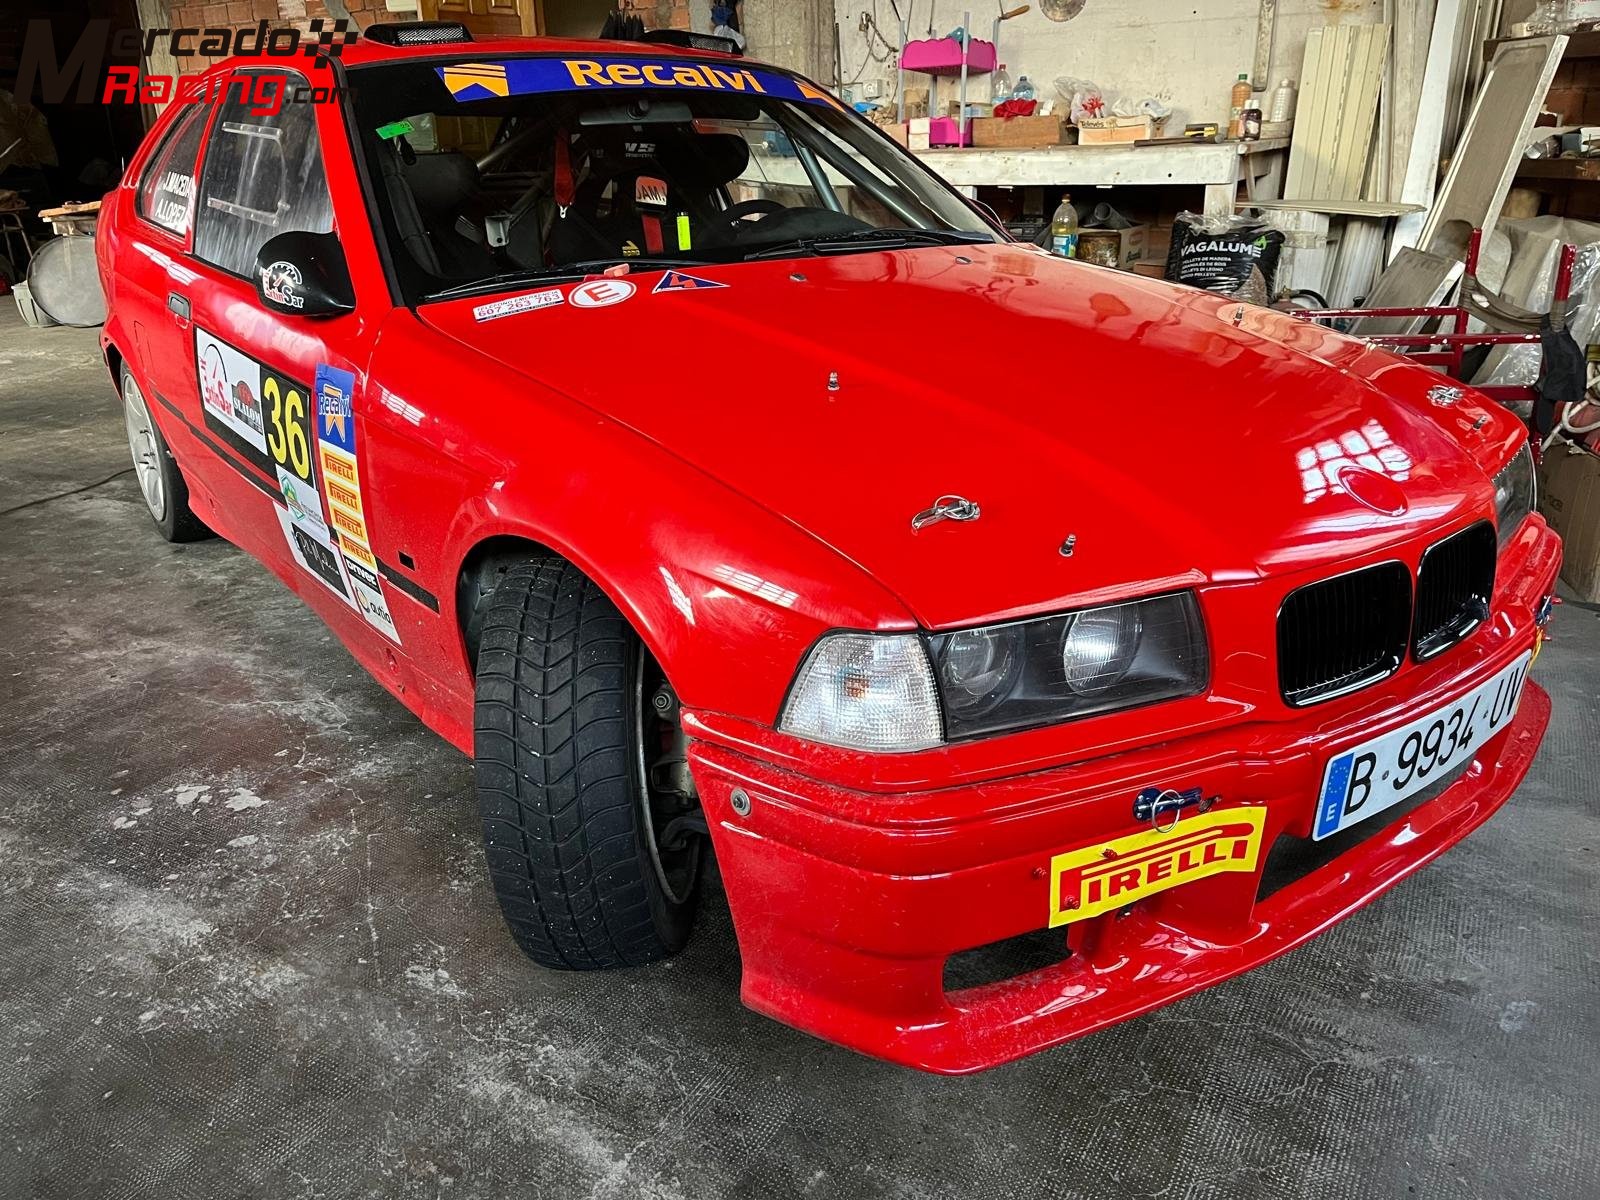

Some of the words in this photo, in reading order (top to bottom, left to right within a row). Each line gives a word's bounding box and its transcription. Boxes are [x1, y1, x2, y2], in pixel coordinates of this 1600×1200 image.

[561, 60, 767, 93] Recalvi
[1181, 241, 1262, 258] VAGALUME
[478, 306, 503, 318] 607
[508, 300, 532, 311] 263
[536, 293, 561, 304] 763
[584, 283, 620, 302] E
[318, 392, 352, 417] Recalvi
[264, 377, 310, 480] 36
[325, 452, 354, 481] PIRELLI
[329, 480, 358, 511] PIRELLI
[334, 508, 363, 538] PIRELLI
[341, 533, 372, 564] PIRELLI
[1343, 752, 1376, 816] B
[1393, 694, 1481, 790] 9934
[1489, 660, 1529, 729] UV
[1325, 803, 1338, 822] E
[1059, 822, 1254, 912] PIRELLI
